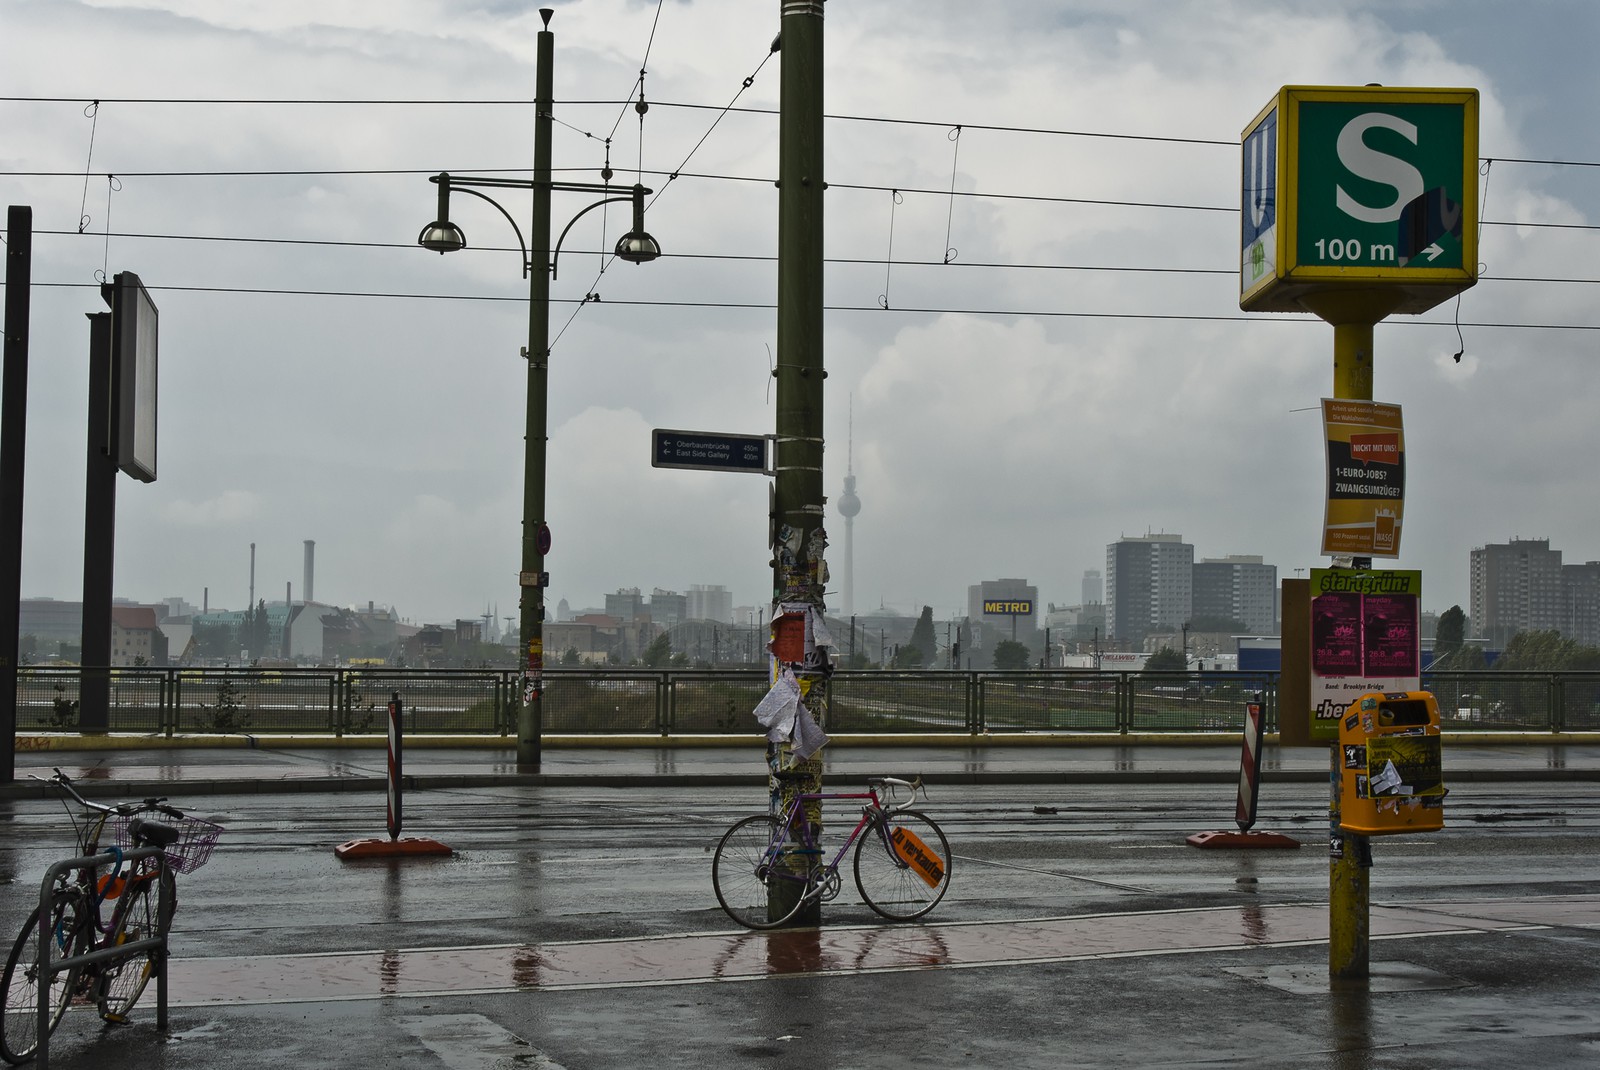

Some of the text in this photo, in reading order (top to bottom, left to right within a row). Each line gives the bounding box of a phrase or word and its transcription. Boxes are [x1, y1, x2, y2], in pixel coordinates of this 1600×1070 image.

[1336, 112, 1424, 223] S
[1250, 124, 1268, 229] U
[1315, 239, 1395, 261] 100 m
[1353, 444, 1396, 452] NICHT MIT UNS!
[676, 449, 691, 457] East
[708, 451, 730, 460] Gallery
[1336, 467, 1387, 480] 1-EURO-JOBS?
[1336, 483, 1400, 496] ZWANGSUMZÜGE?
[1376, 533, 1392, 542] WASG
[1366, 597, 1392, 605] mayday
[985, 602, 1029, 613] METRO
[1343, 683, 1366, 691] Brooklyn
[903, 838, 944, 882] verkaufen
